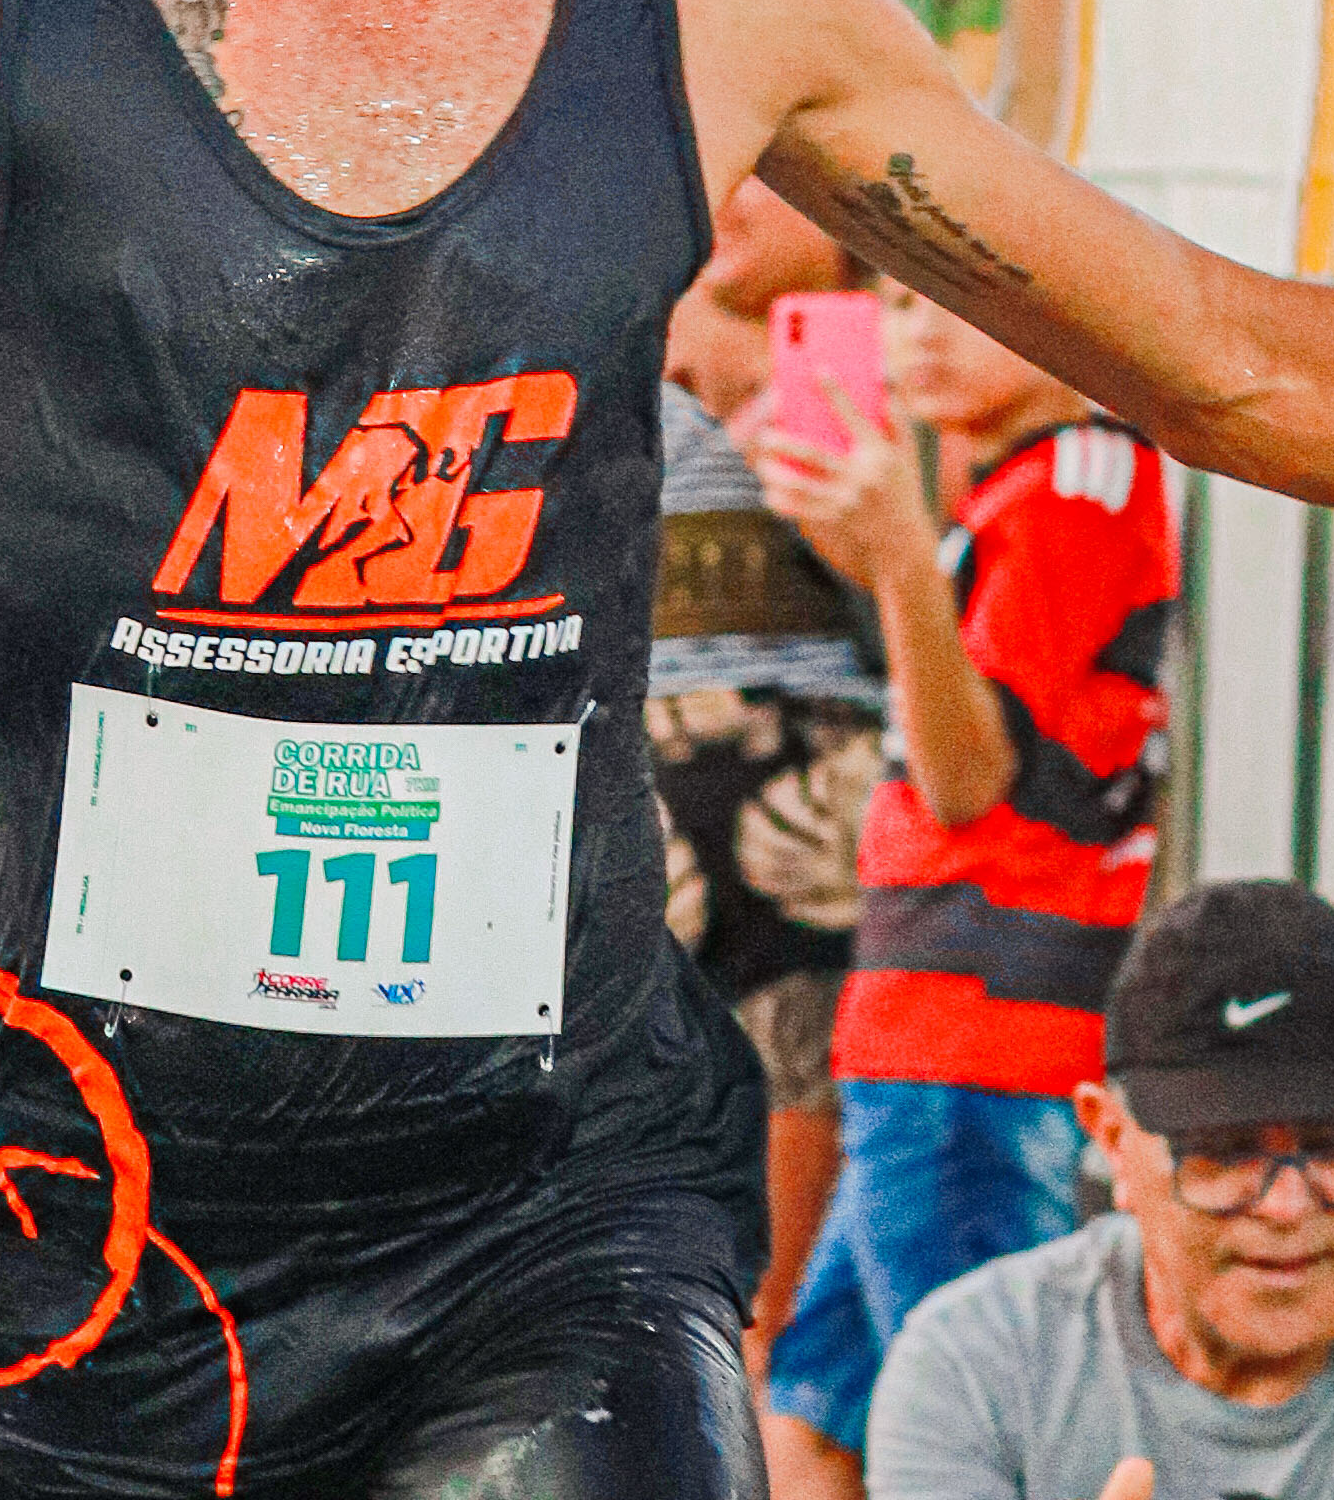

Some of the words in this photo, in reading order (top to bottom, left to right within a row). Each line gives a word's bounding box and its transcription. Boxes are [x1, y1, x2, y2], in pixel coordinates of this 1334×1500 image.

[152, 370, 578, 608] MG
[109, 615, 378, 676] ASSESSORIA
[384, 613, 585, 676] ESPORTIVA
[274, 738, 421, 771] CORRIDA
[271, 766, 318, 796] DE
[325, 768, 392, 798] RUA
[269, 800, 377, 819] Emancipação
[380, 802, 438, 818] Política
[299, 820, 340, 836] Nova
[344, 822, 409, 838] Floresta
[255, 848, 438, 963] 111
